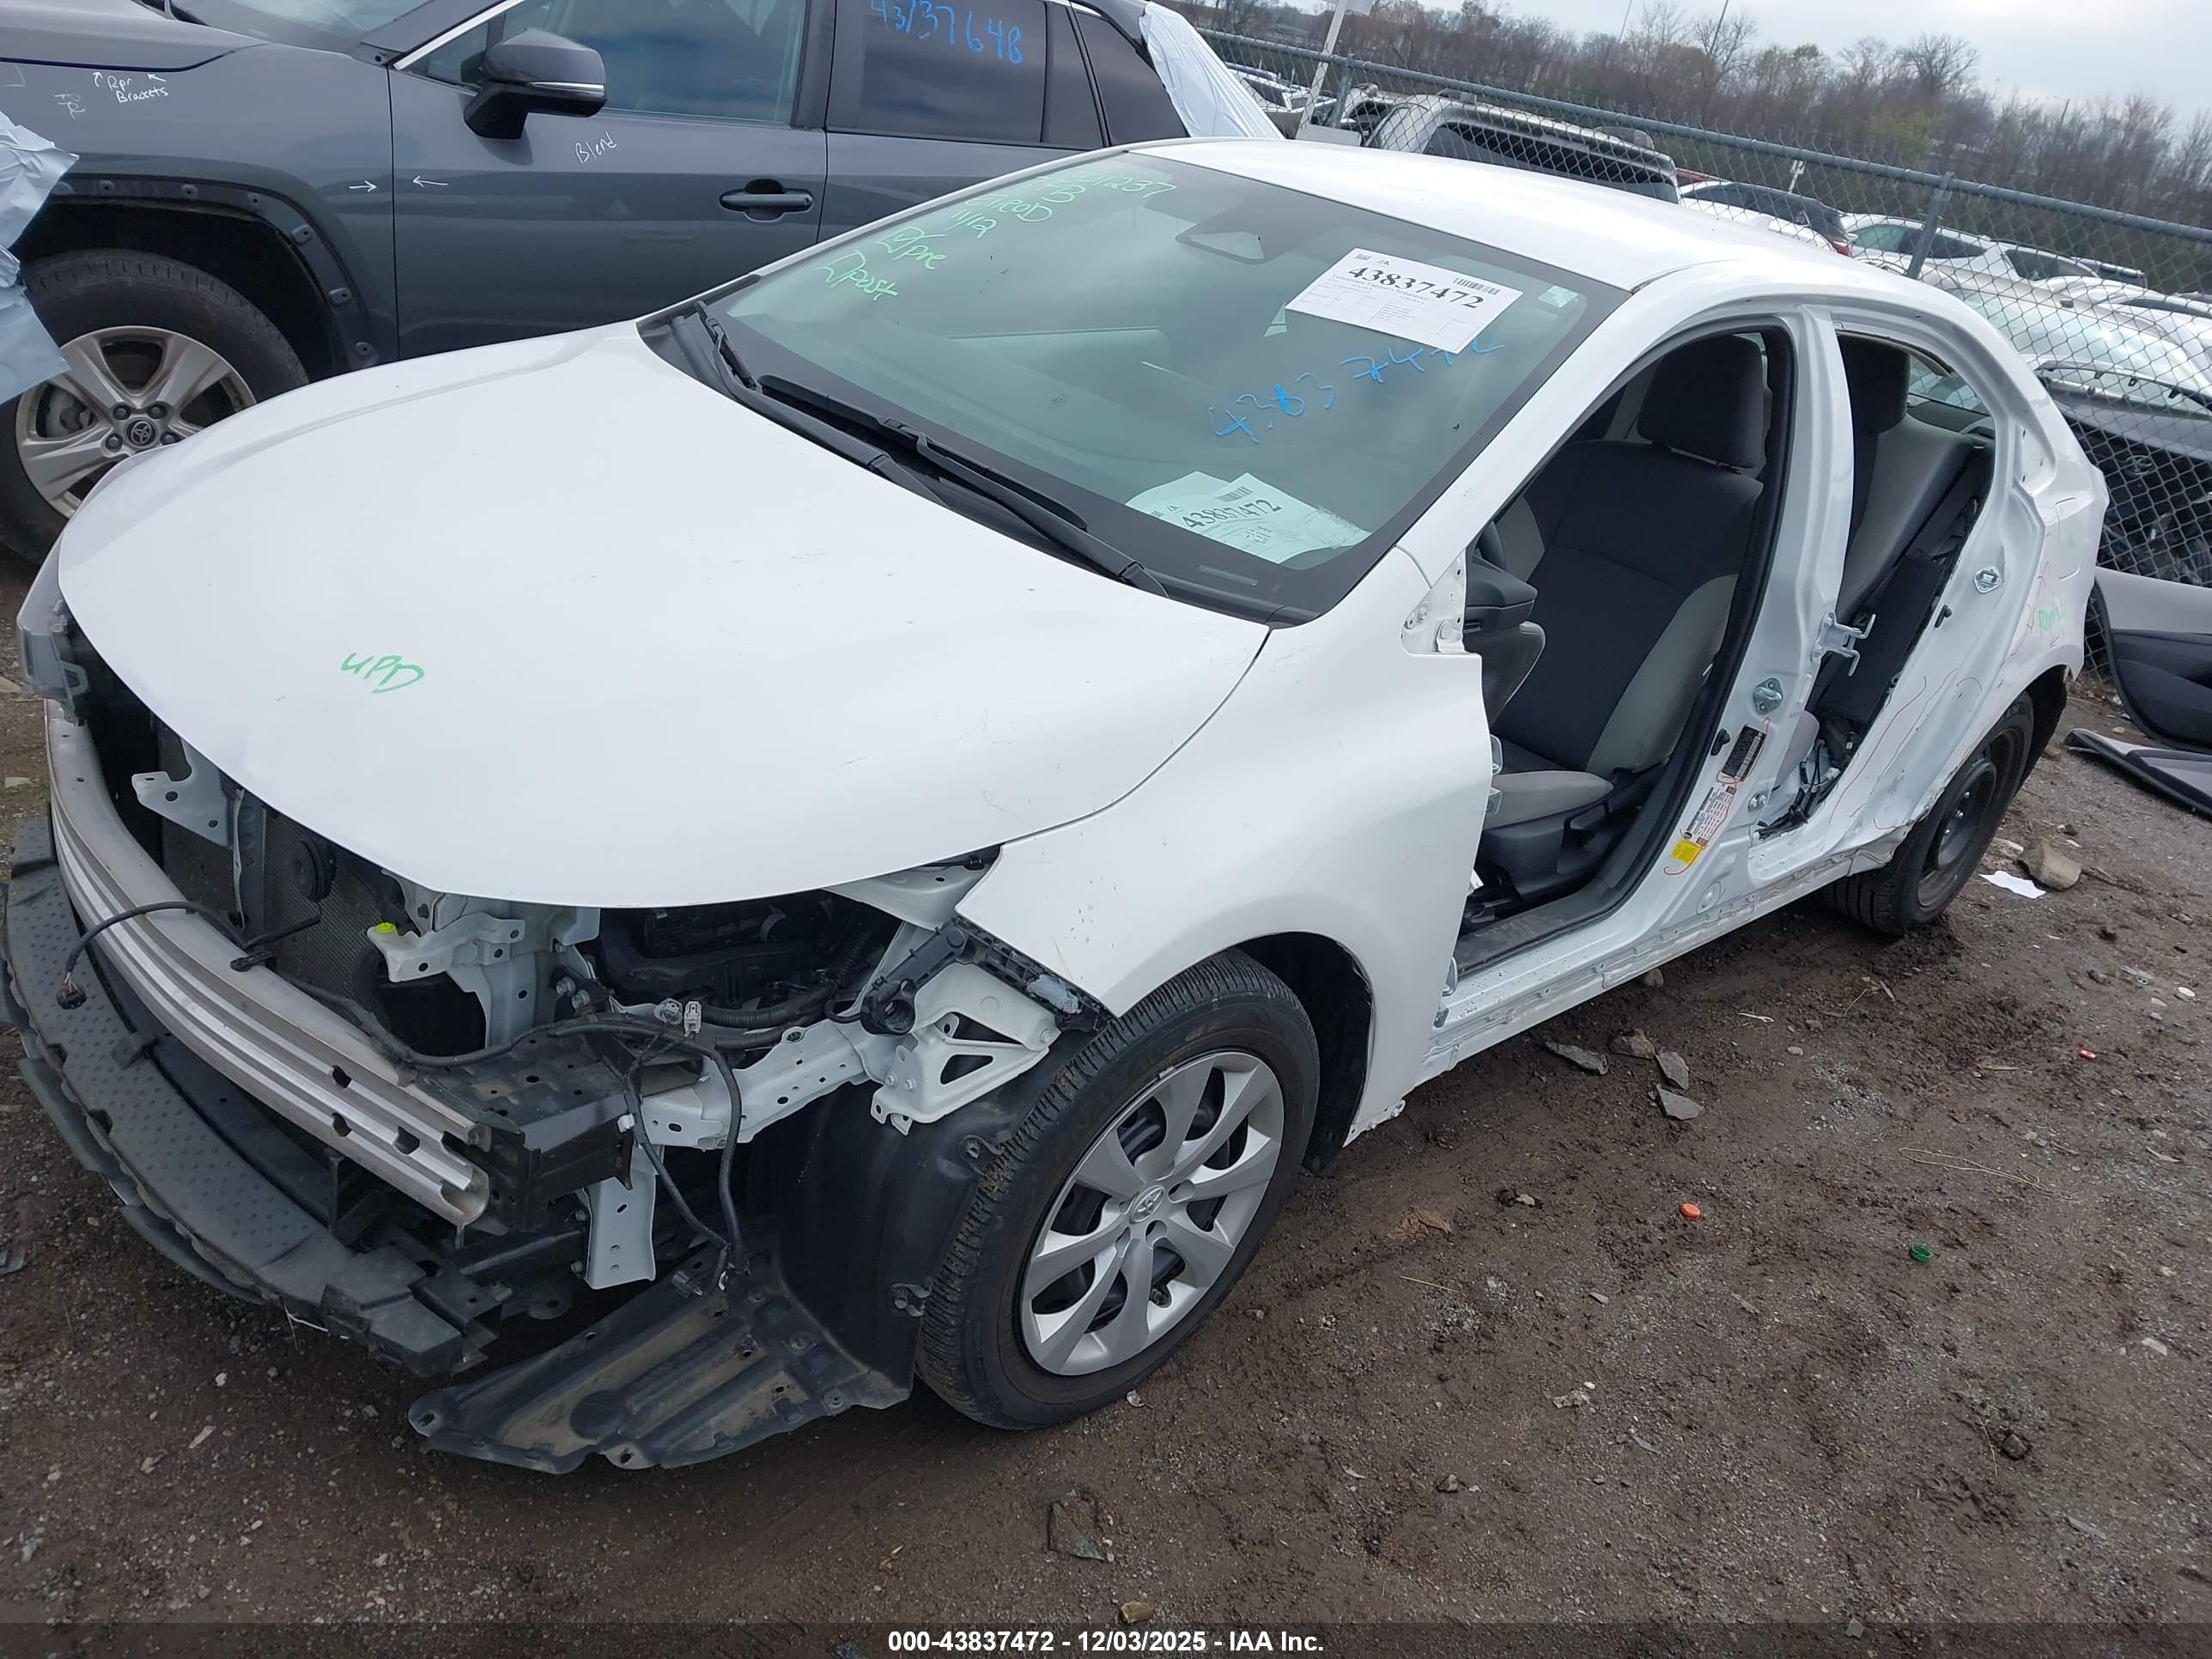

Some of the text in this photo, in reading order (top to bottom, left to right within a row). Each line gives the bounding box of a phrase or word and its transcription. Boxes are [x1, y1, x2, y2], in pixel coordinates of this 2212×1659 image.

[575, 131, 617, 164] Blend
[1348, 266, 1484, 309] 43837472
[1182, 499, 1282, 529] 43837472
